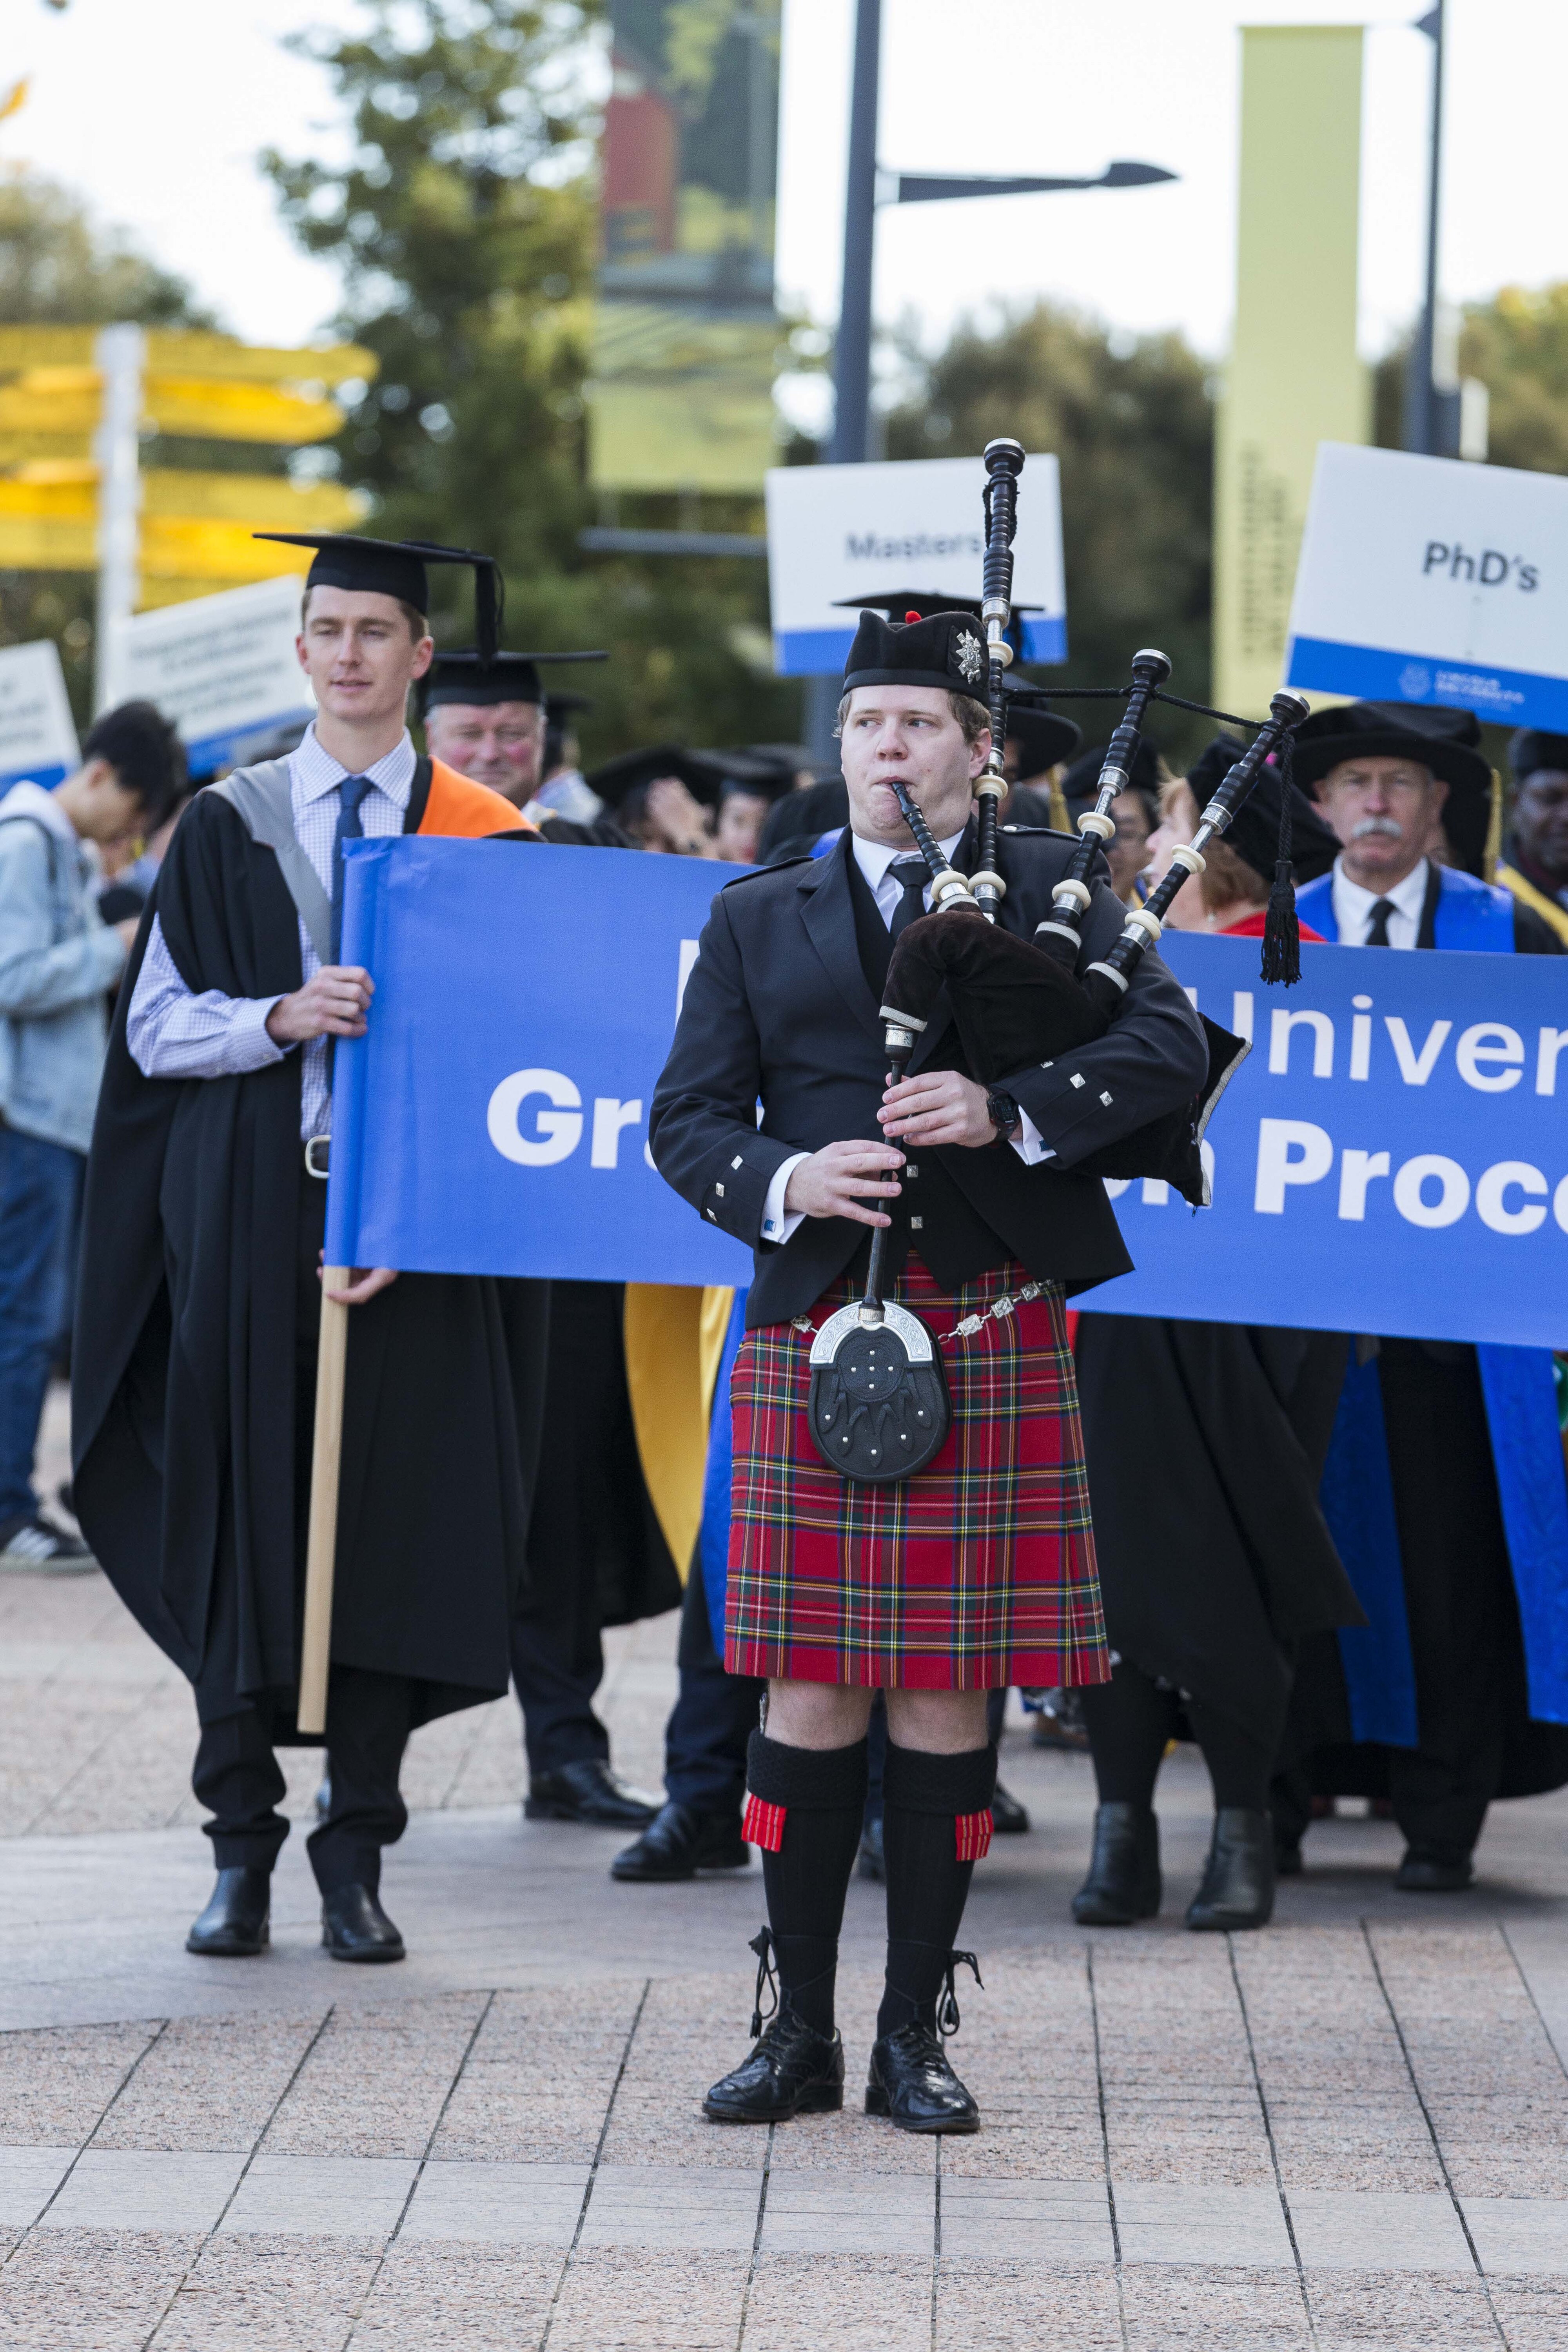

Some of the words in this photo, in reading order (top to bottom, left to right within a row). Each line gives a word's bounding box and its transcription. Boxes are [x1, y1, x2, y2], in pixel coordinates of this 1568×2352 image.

[846, 530, 983, 561] Masters
[1423, 540, 1540, 592] PhD's
[486, 1067, 658, 1172] Gr
